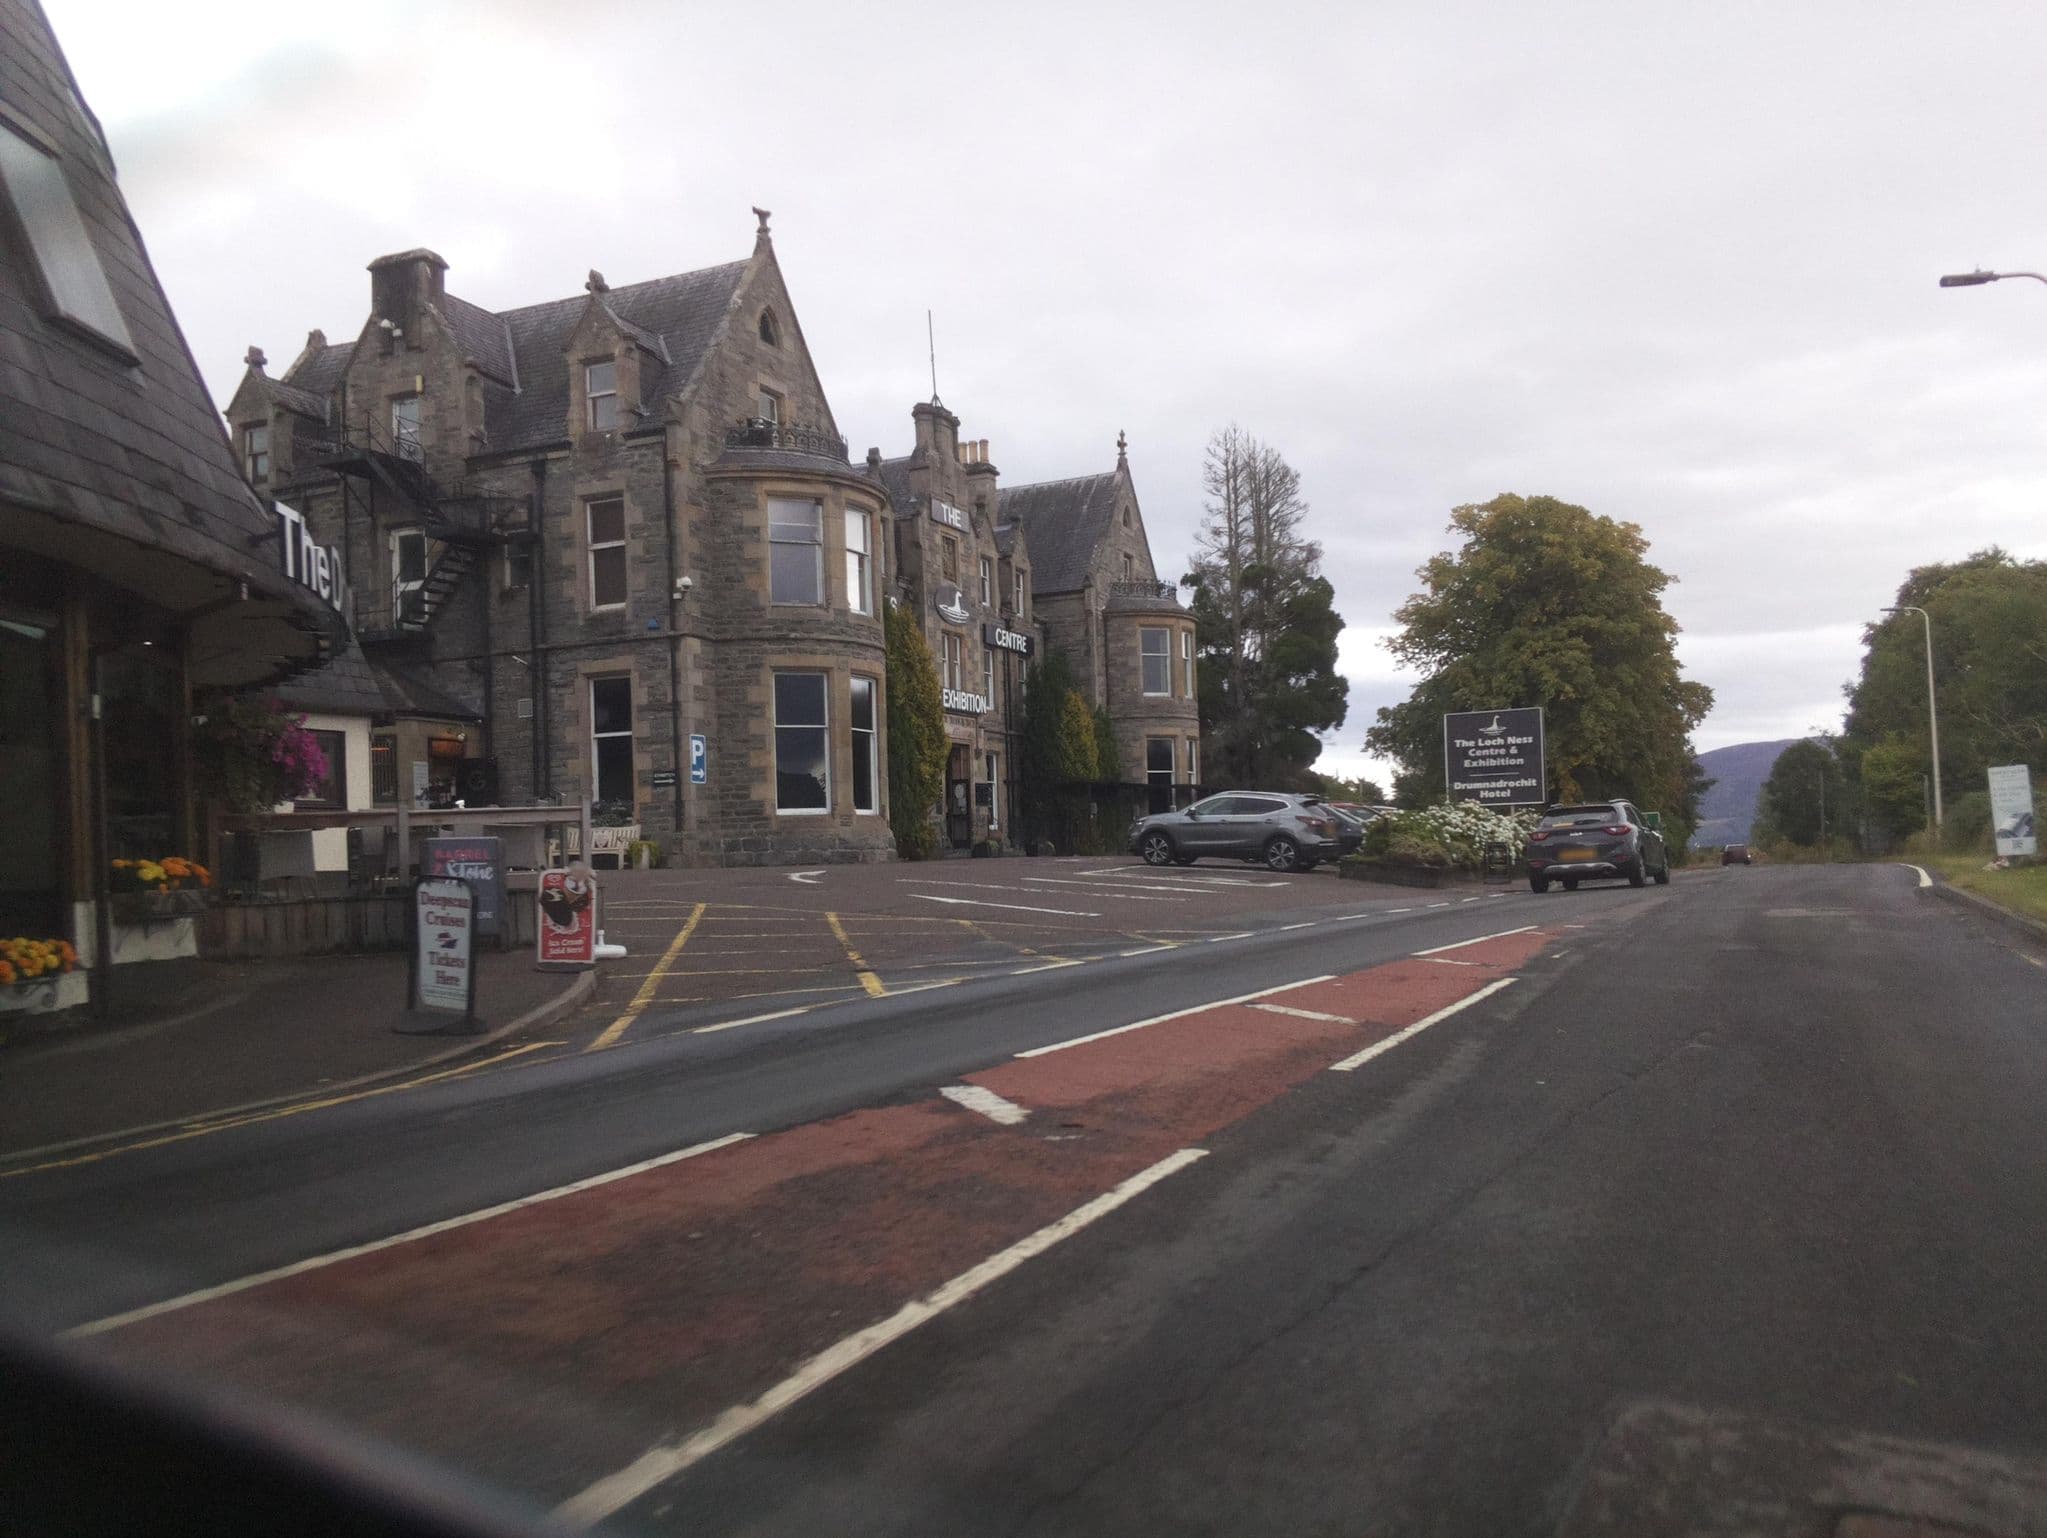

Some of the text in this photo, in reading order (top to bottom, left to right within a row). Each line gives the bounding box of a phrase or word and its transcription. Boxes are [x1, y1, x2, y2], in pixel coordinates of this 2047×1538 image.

[941, 503, 962, 528] THE
[275, 500, 331, 600] The
[995, 628, 1027, 653] CENTRE
[943, 688, 987, 714] EXHIBITION
[1454, 736, 1534, 748] The Loch Ness
[692, 740, 704, 765] P
[1468, 745, 1519, 757] Centre &
[1463, 757, 1525, 768] Exhibition
[1454, 778, 1537, 790] Drumnadrochit
[1479, 789, 1511, 798] Hotel
[425, 911, 466, 928] Cruises
[429, 951, 466, 969] Tickets
[435, 970, 460, 985] Here
